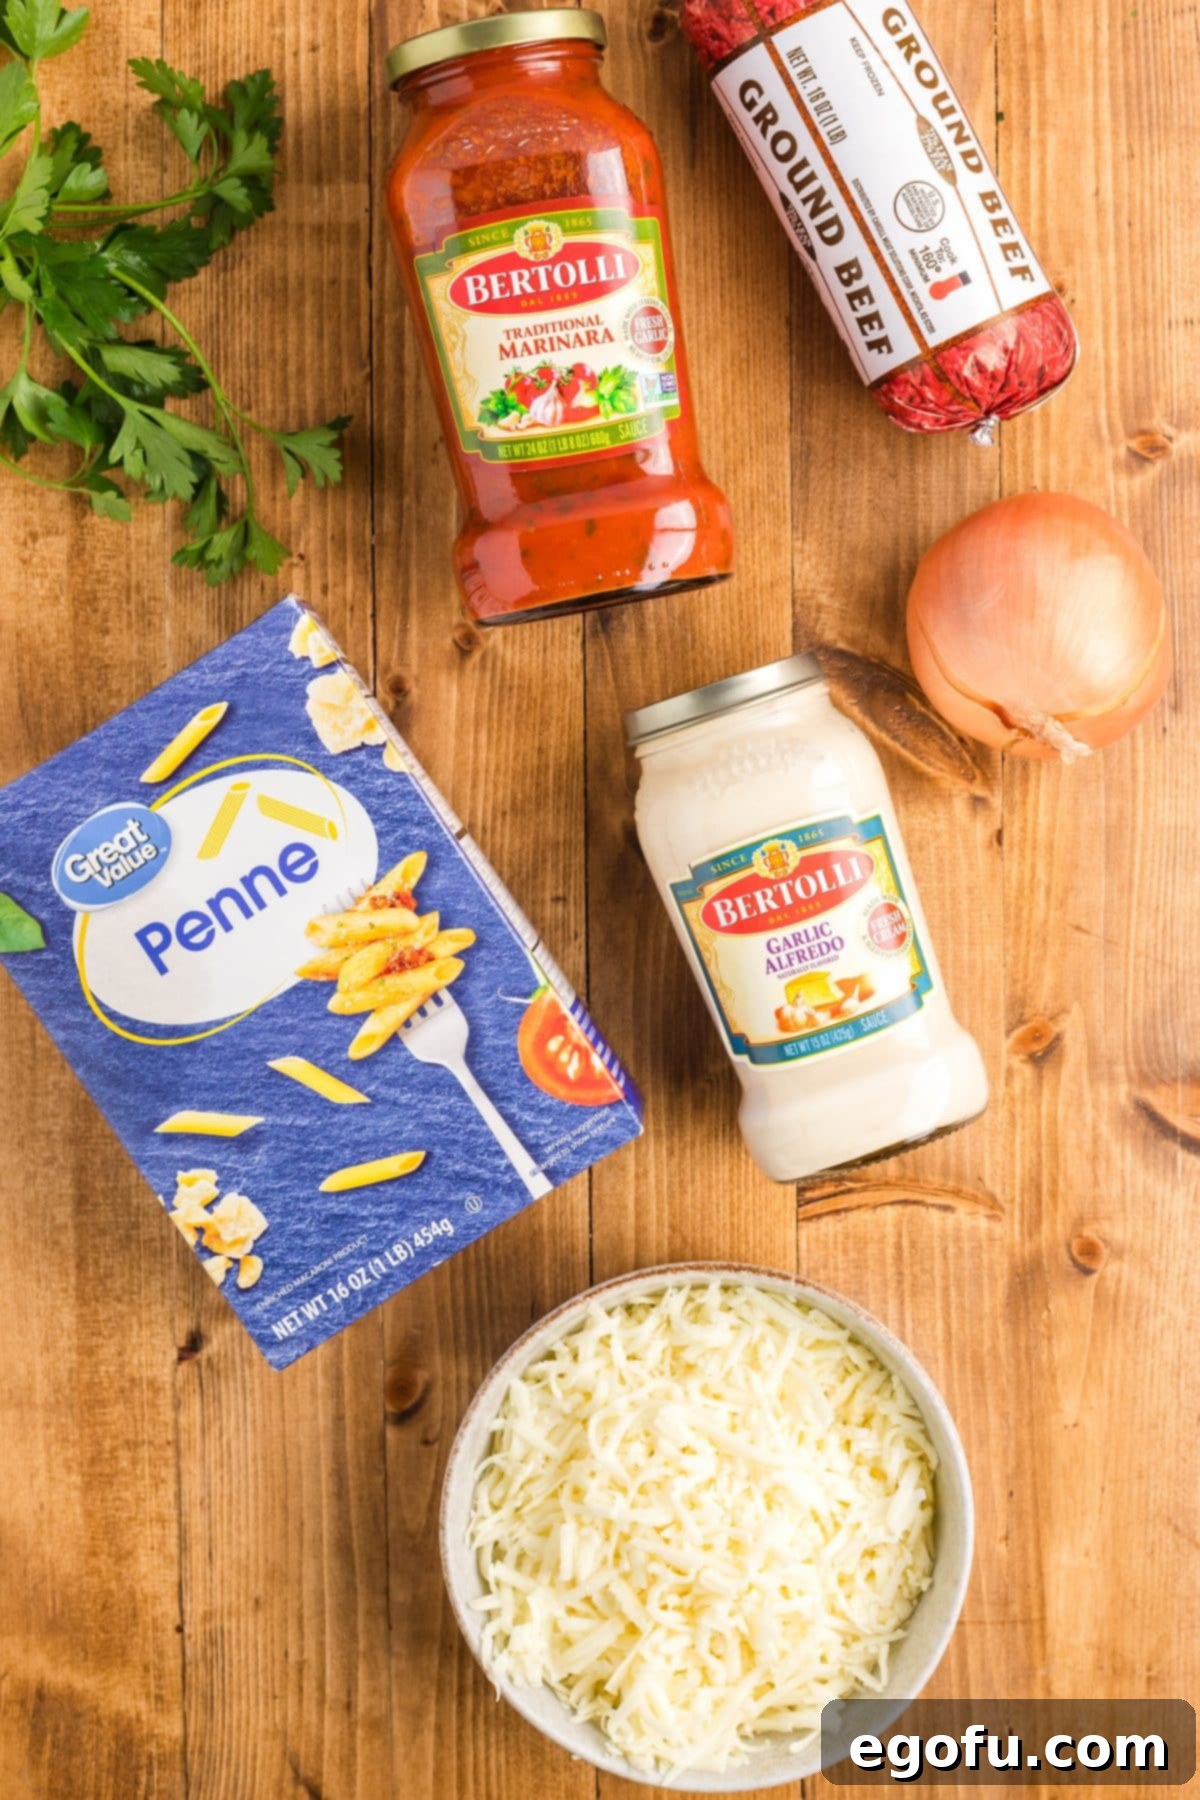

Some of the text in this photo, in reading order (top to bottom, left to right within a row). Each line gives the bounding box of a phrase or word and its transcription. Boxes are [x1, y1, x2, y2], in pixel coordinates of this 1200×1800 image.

[850, 37, 885, 96] KEEP FROZEN
[785, 45, 848, 146] NET WT. 16 OZ (1 LB)
[882, 7, 1035, 283] GROUND BEEF
[468, 216, 592, 247] SINCE 1865
[739, 79, 844, 246] GROUND
[835, 257, 893, 355] BEEF
[909, 248, 931, 283] MINIMUM
[935, 246, 946, 264] To:
[940, 237, 958, 265] Cook
[464, 253, 628, 305] BERTOLLI
[520, 297, 543, 308] DAL
[503, 314, 603, 341] TRADITIONAL
[634, 314, 665, 330] FRESH
[498, 328, 615, 361] MARINARA
[498, 445, 512, 458] NET
[514, 444, 525, 456] WT
[527, 444, 536, 455] 24
[538, 442, 547, 454] OZ
[558, 440, 567, 451] LB
[618, 421, 648, 440] SAUCE
[64, 818, 149, 884] Great
[94, 843, 156, 889] Value
[711, 829, 824, 874] SINCE 1865
[134, 842, 319, 977] Penne
[711, 856, 863, 928] BERTOLLI
[768, 912, 789, 925] DAL
[870, 910, 900, 930] FRESH
[871, 924, 908, 943] CREAM
[764, 936, 845, 975] ALFREDO
[766, 922, 832, 955] GARLIC
[777, 954, 839, 979] NATURALLY FLAVORED
[784, 1010, 888, 1056] NET WT 15 OZ (425g) SAUCE
[542, 1108, 611, 1154] serving suggestion
[568, 1132, 591, 1150] show
[256, 1233, 369, 1310] ENRICHED MACARONI PRODUCT
[270, 1216, 454, 1340] NET WT 16 OZ (1 LB) 454g
